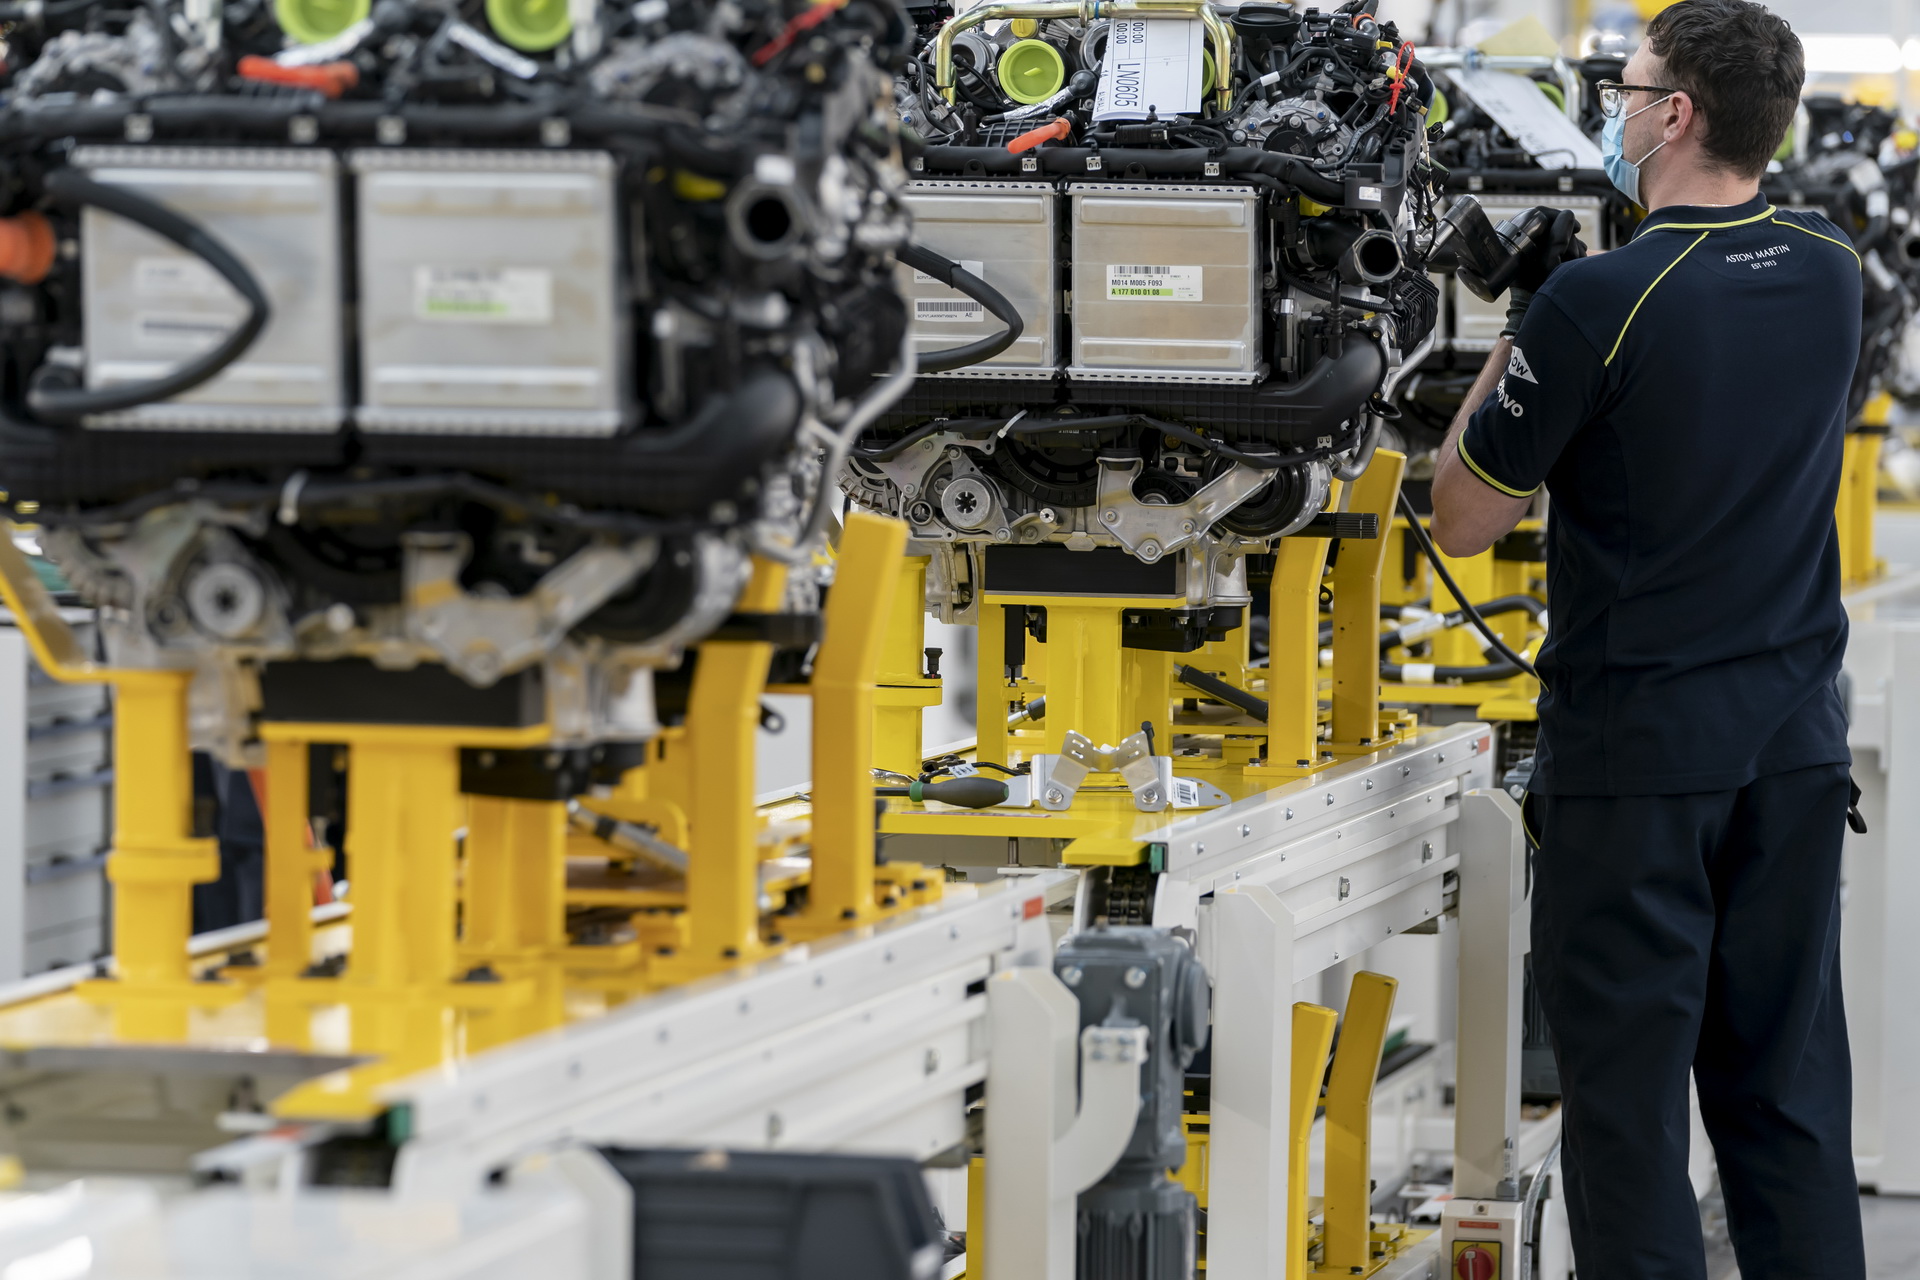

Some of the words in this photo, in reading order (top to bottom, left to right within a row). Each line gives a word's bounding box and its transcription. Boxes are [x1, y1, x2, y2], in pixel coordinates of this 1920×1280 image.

[1114, 63, 1141, 107] LN0605
[1725, 252, 1754, 263] ASTON
[1755, 244, 1791, 259] MARTIN
[1762, 260, 1777, 268] 1913
[1130, 288, 1142, 296] 010
[1143, 288, 1151, 296] 01
